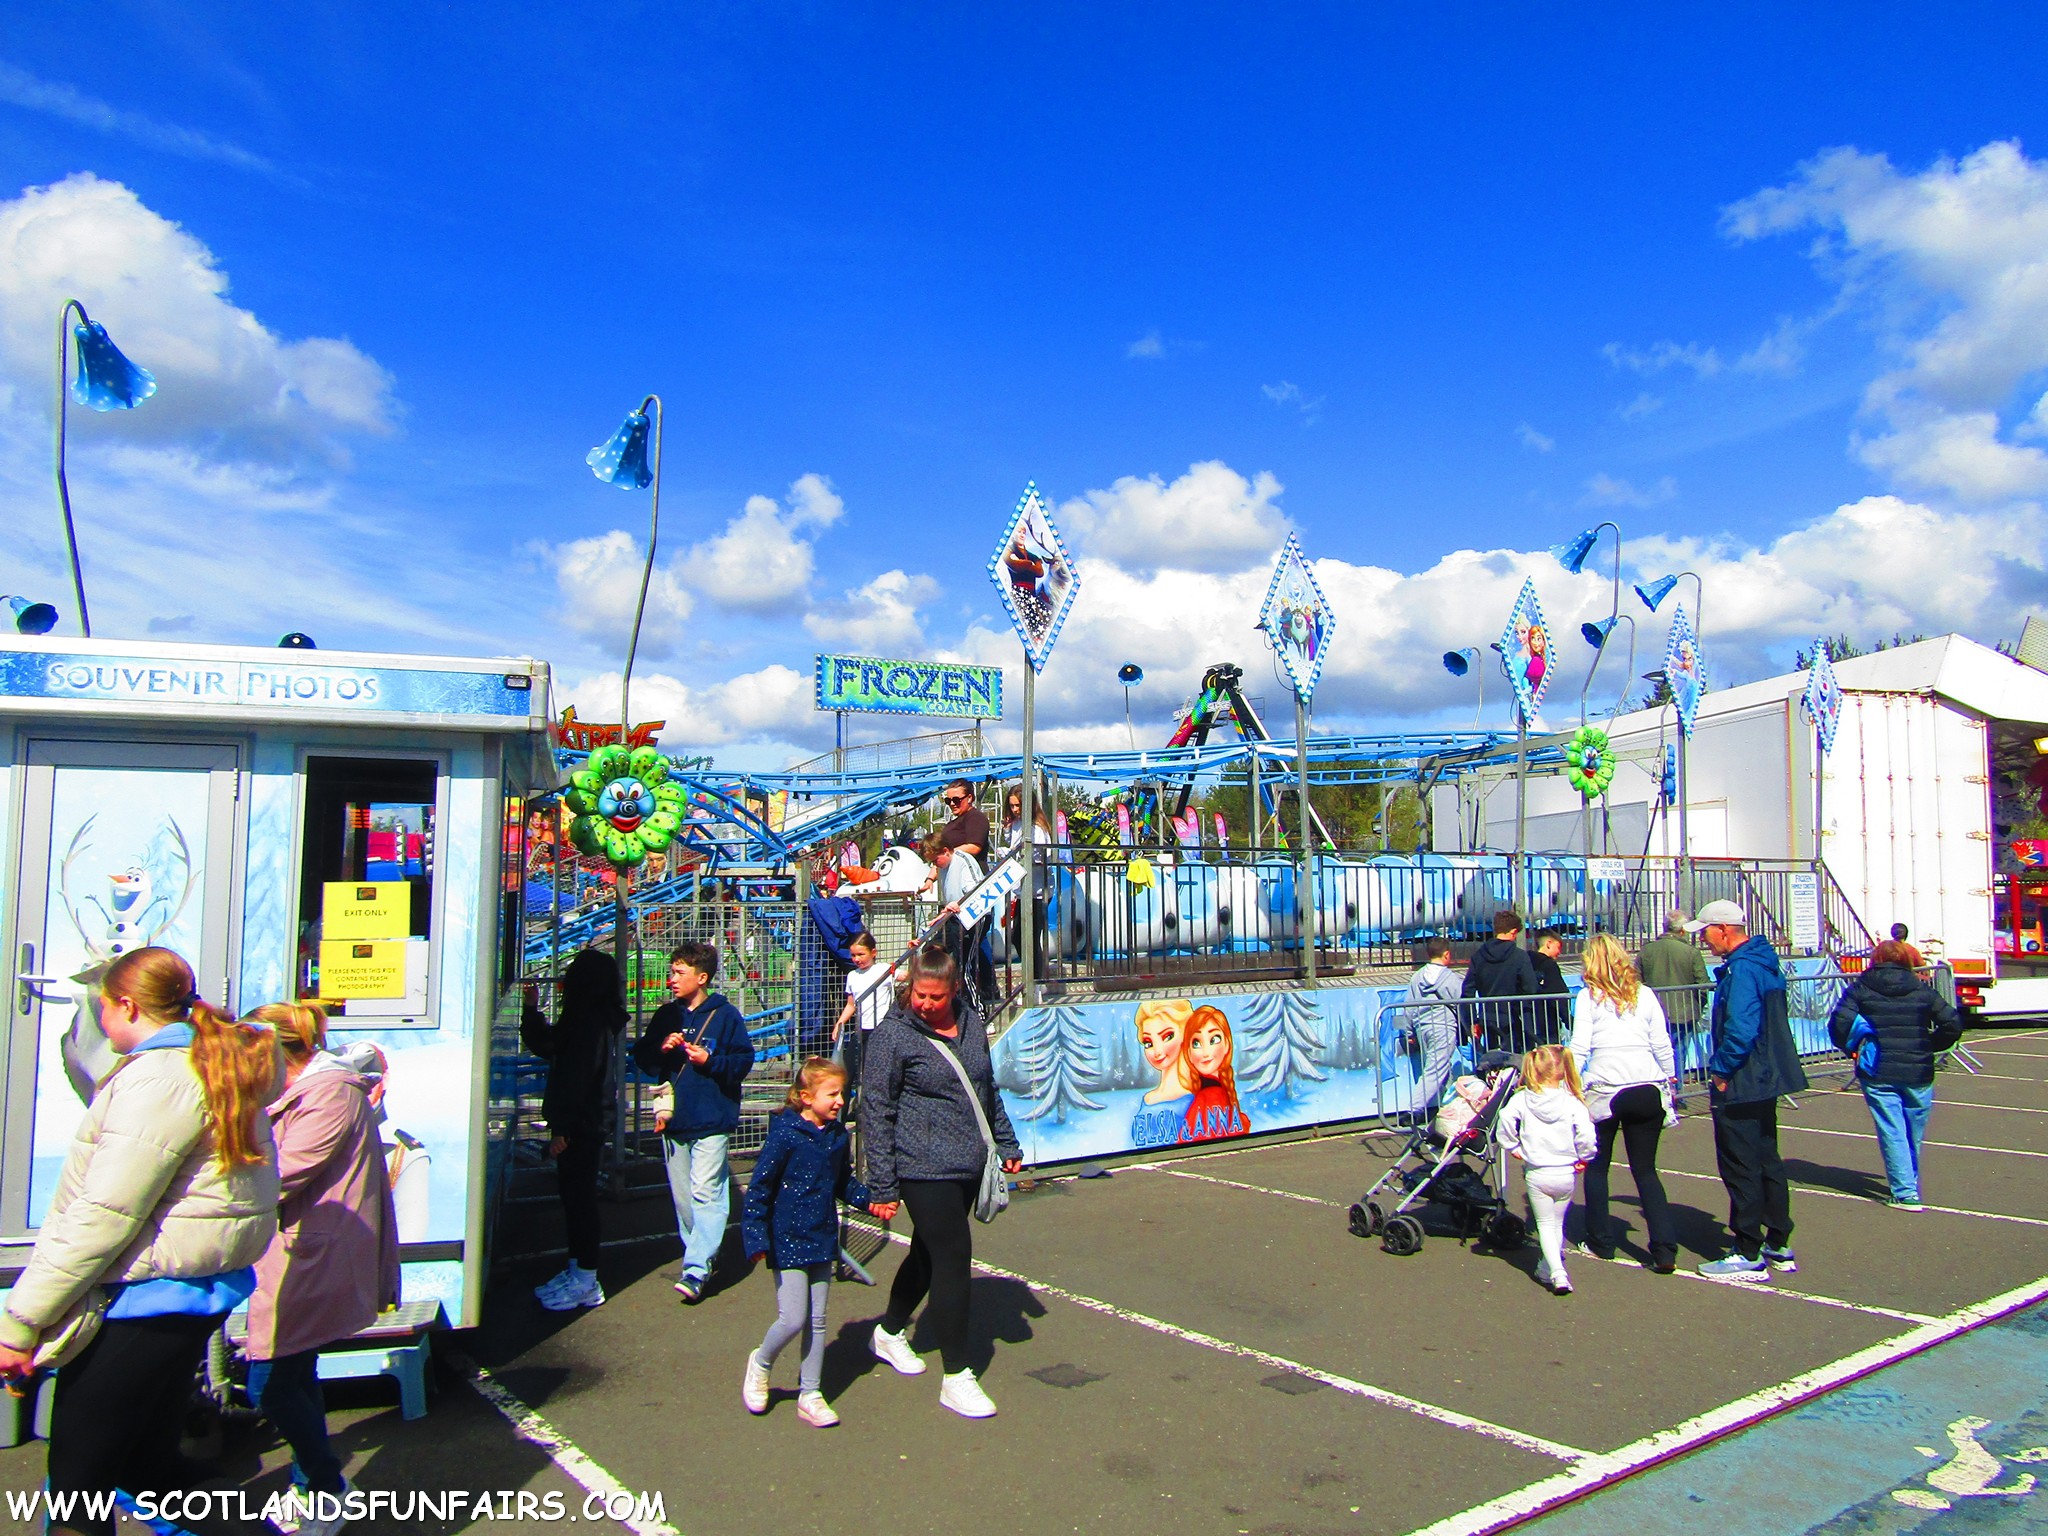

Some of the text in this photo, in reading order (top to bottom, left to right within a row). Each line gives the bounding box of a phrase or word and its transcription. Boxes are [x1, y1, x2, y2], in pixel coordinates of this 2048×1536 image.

[50, 664, 378, 700] SOUVENIR PHOTOS
[832, 658, 992, 705] FROZEN
[925, 700, 991, 717] COASTER
[344, 909, 362, 917] EXIT
[965, 866, 1011, 920] EXIT
[1133, 1103, 1244, 1147] ELSA & ANNA
